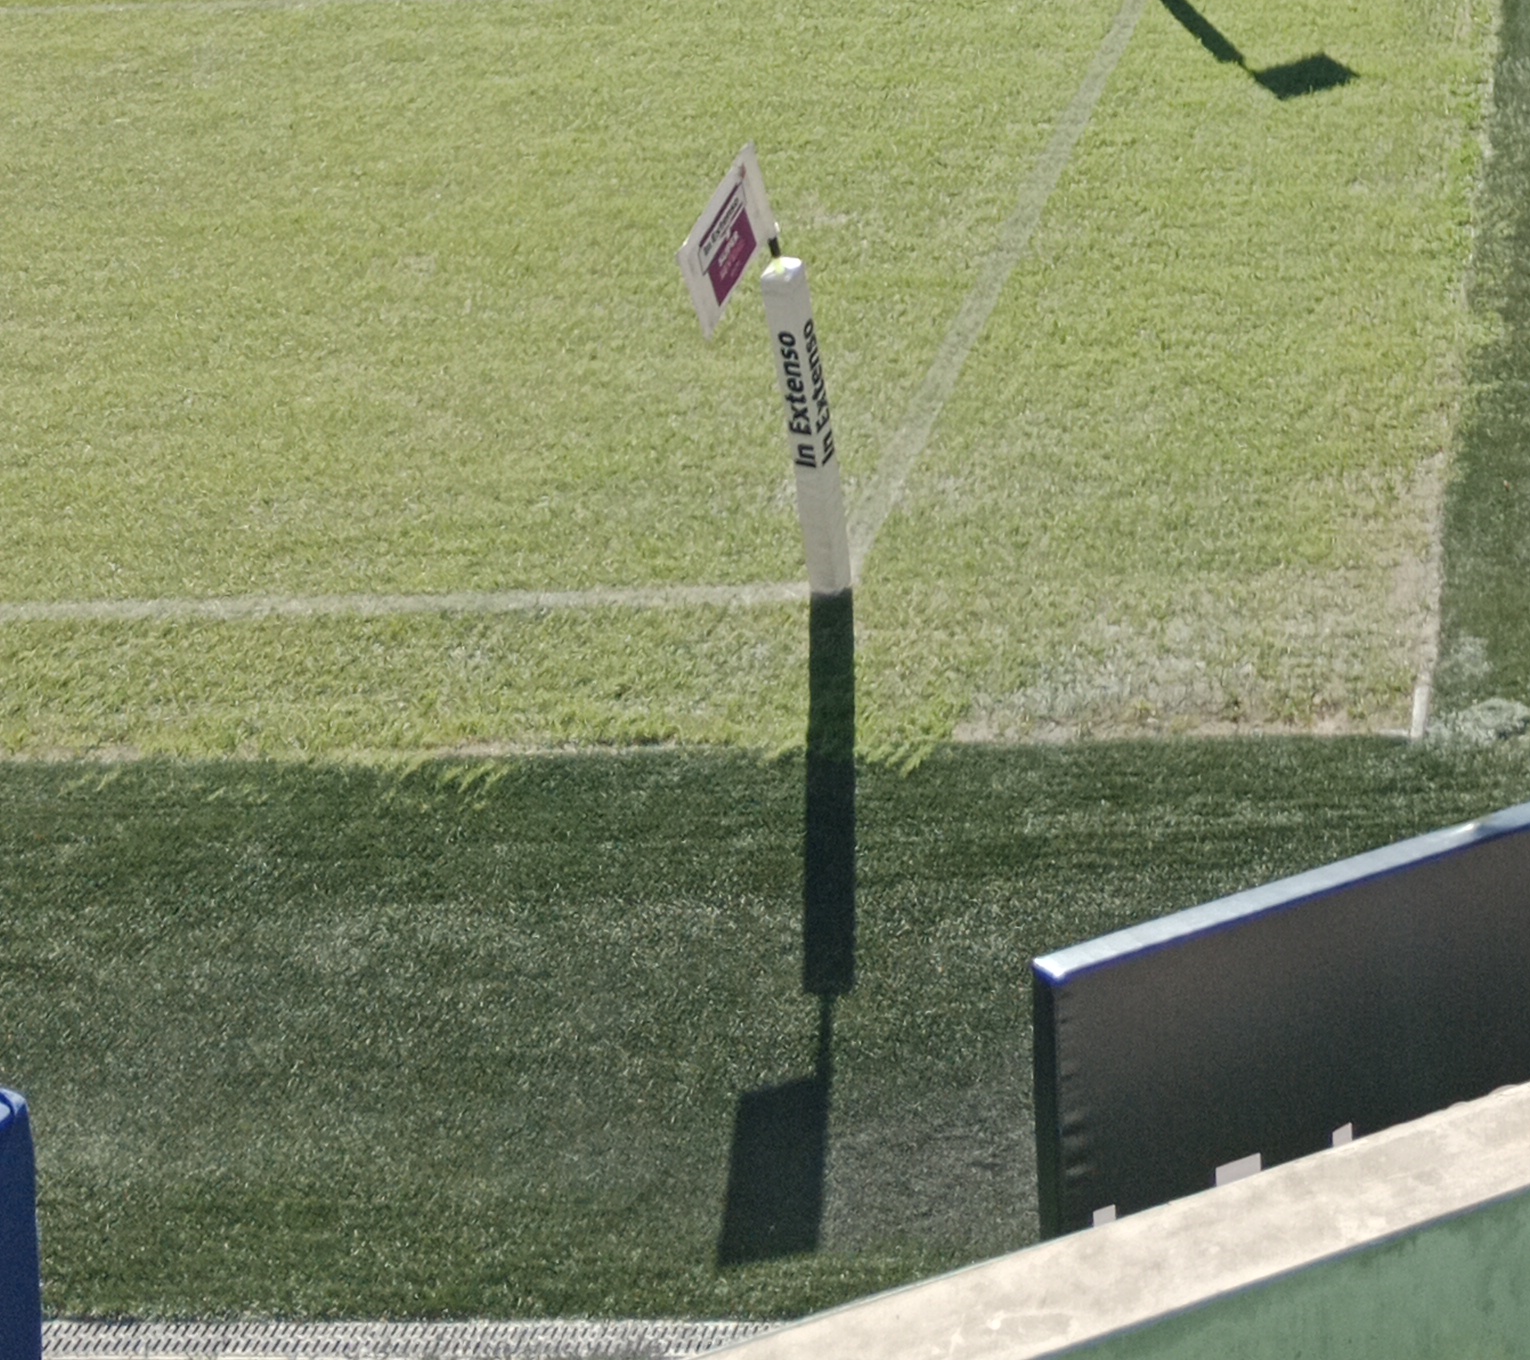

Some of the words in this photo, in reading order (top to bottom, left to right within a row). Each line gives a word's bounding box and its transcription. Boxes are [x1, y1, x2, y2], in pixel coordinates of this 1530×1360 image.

[778, 331, 812, 435] Extenso
[803, 318, 830, 433] Extenso
[795, 443, 816, 468] In
[822, 429, 835, 466] In
